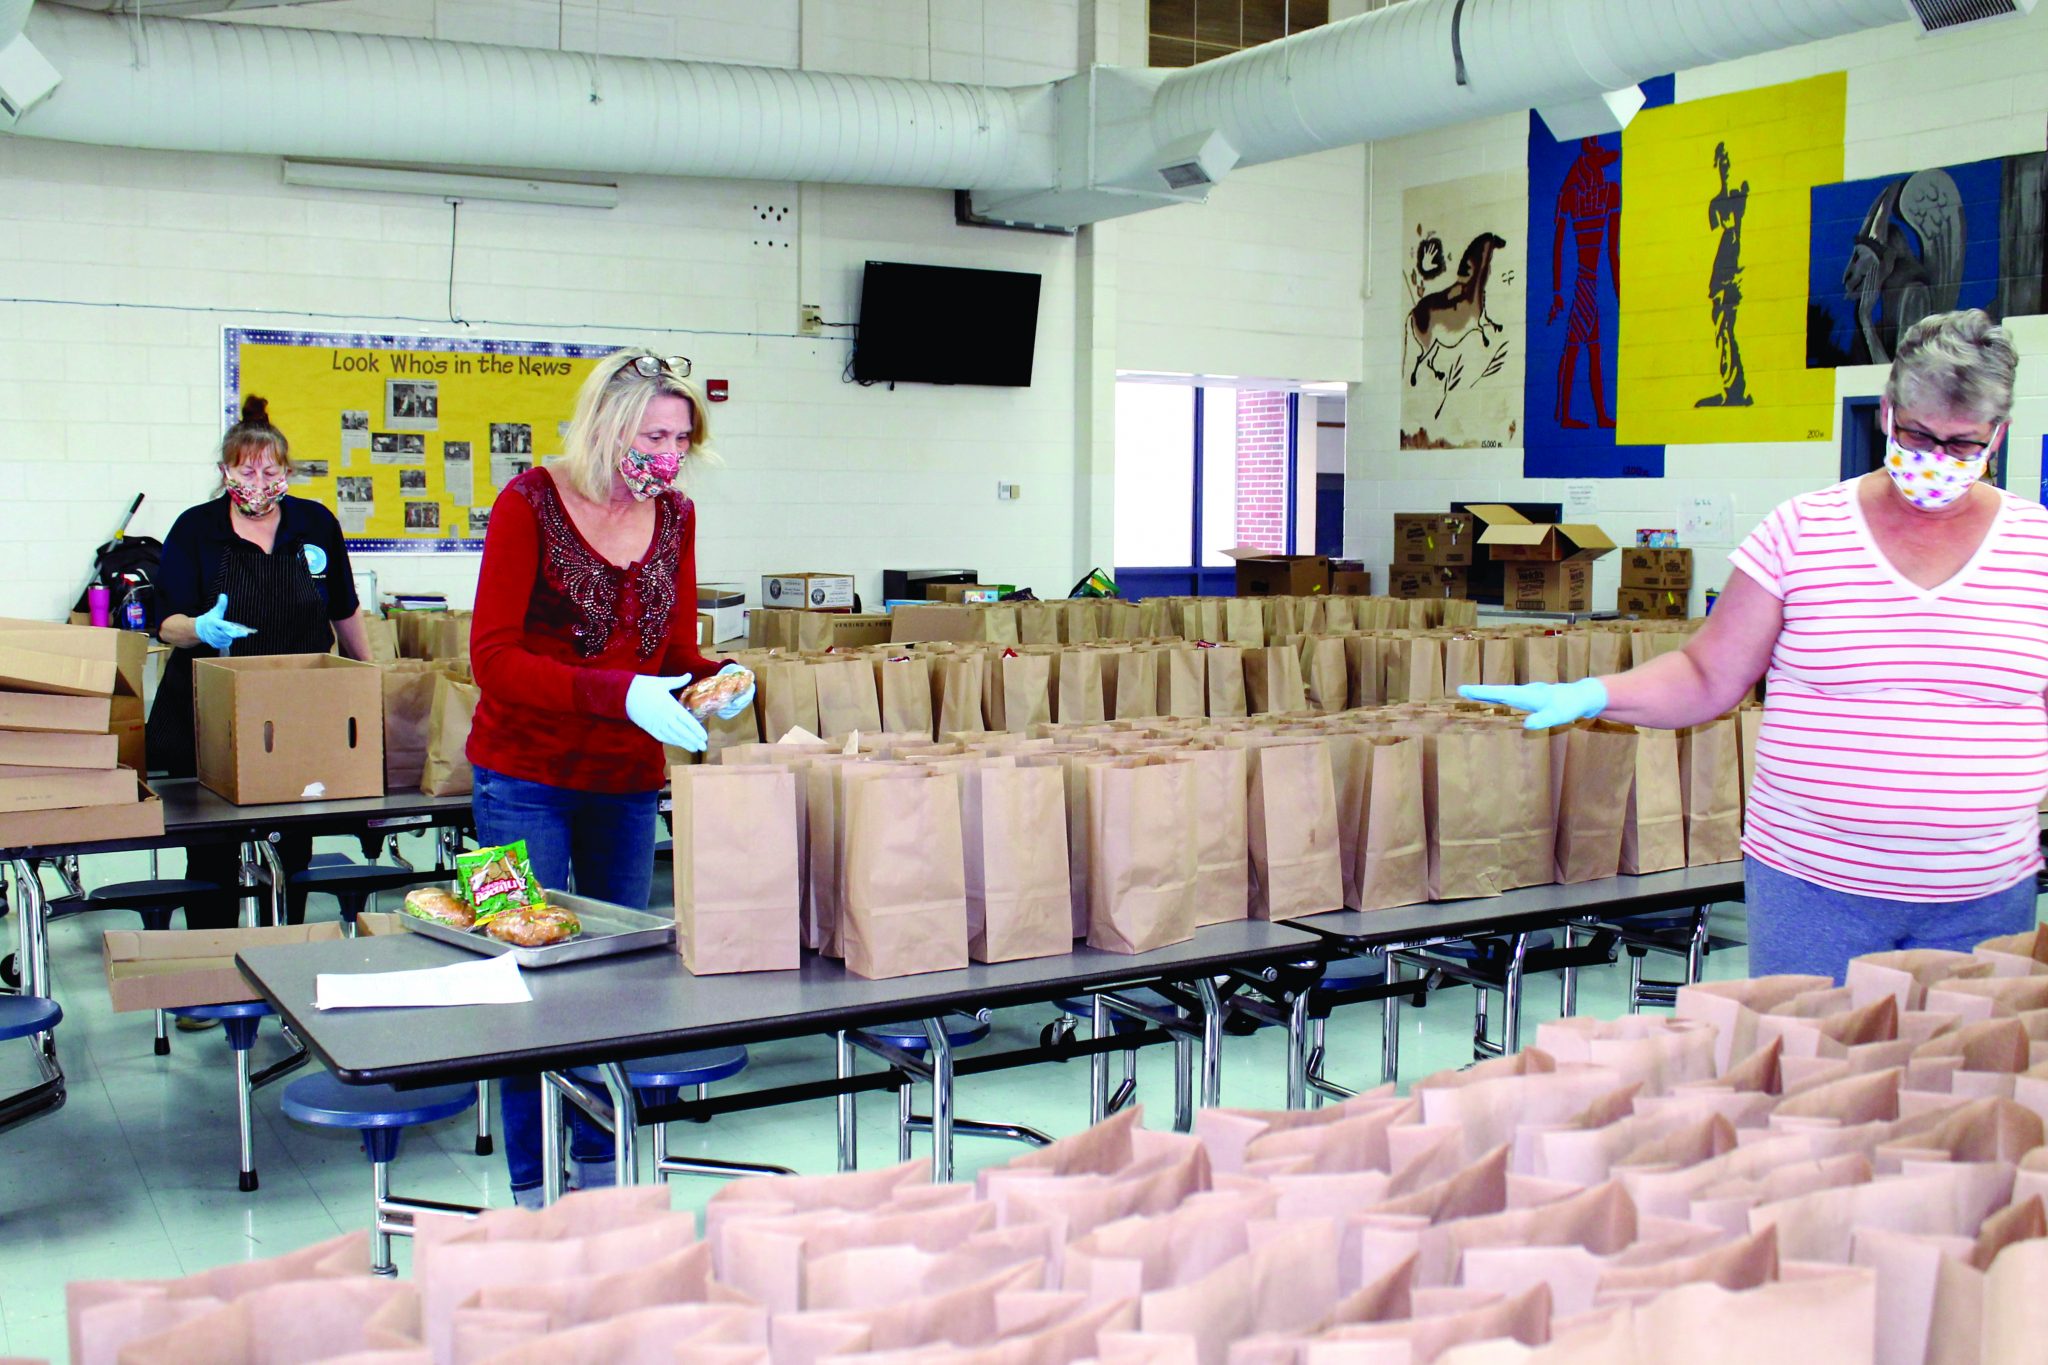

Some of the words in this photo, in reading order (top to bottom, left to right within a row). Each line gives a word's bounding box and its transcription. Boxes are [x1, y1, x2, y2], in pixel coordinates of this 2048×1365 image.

[332, 350, 379, 373] Look
[390, 354, 448, 375] Who's
[454, 354, 471, 373] in
[477, 355, 514, 374] the
[518, 356, 572, 376] News
